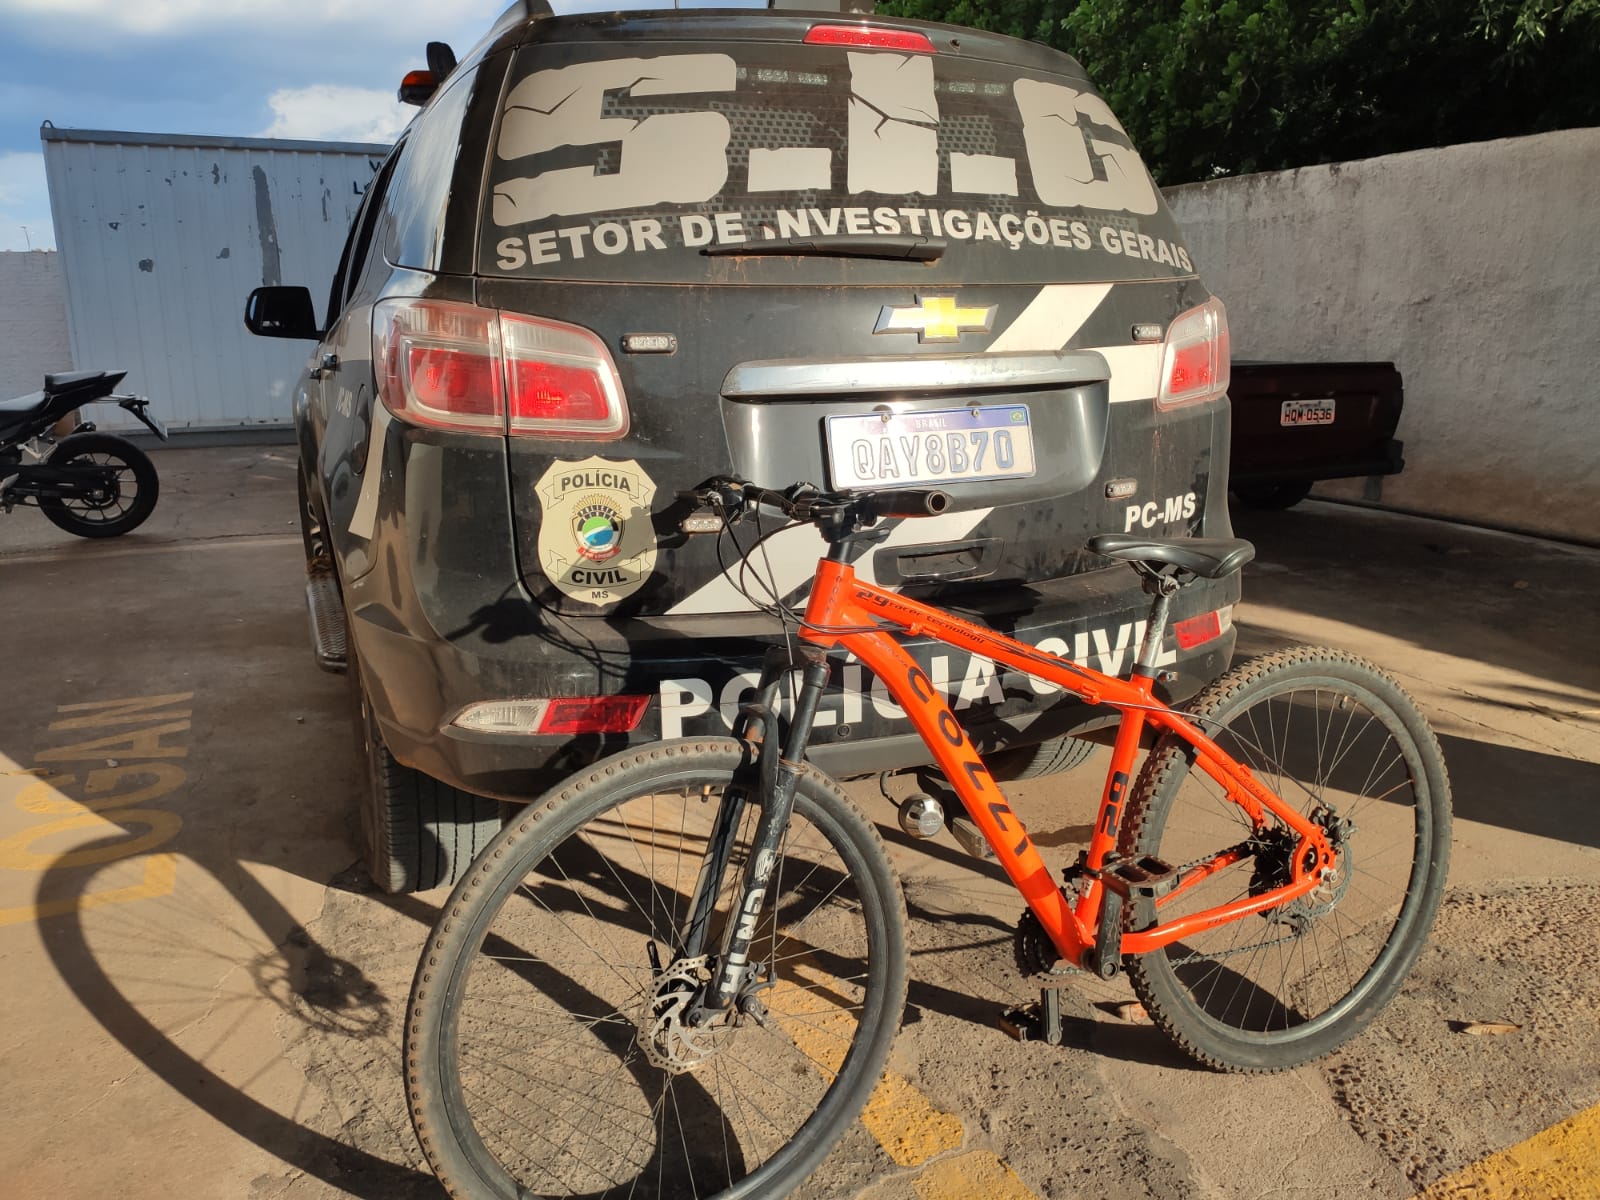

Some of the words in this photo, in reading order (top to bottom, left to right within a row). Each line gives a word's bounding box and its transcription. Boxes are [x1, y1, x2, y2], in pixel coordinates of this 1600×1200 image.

[496, 219, 667, 271] SETOR
[680, 212, 747, 248] DE
[1100, 227, 1194, 272] GERAIS
[915, 417, 947, 429] BRASIL
[851, 430, 1015, 480] QAY8B70
[561, 469, 631, 492] POLÍCIA
[1124, 492, 1196, 533] PC-MS
[571, 569, 628, 585] CIVIL
[591, 590, 609, 599] MS
[856, 590, 890, 607] 29
[1028, 620, 1177, 695] CIVIL
[907, 665, 1029, 857] COLLI
[0, 692, 194, 928] LOGAN
